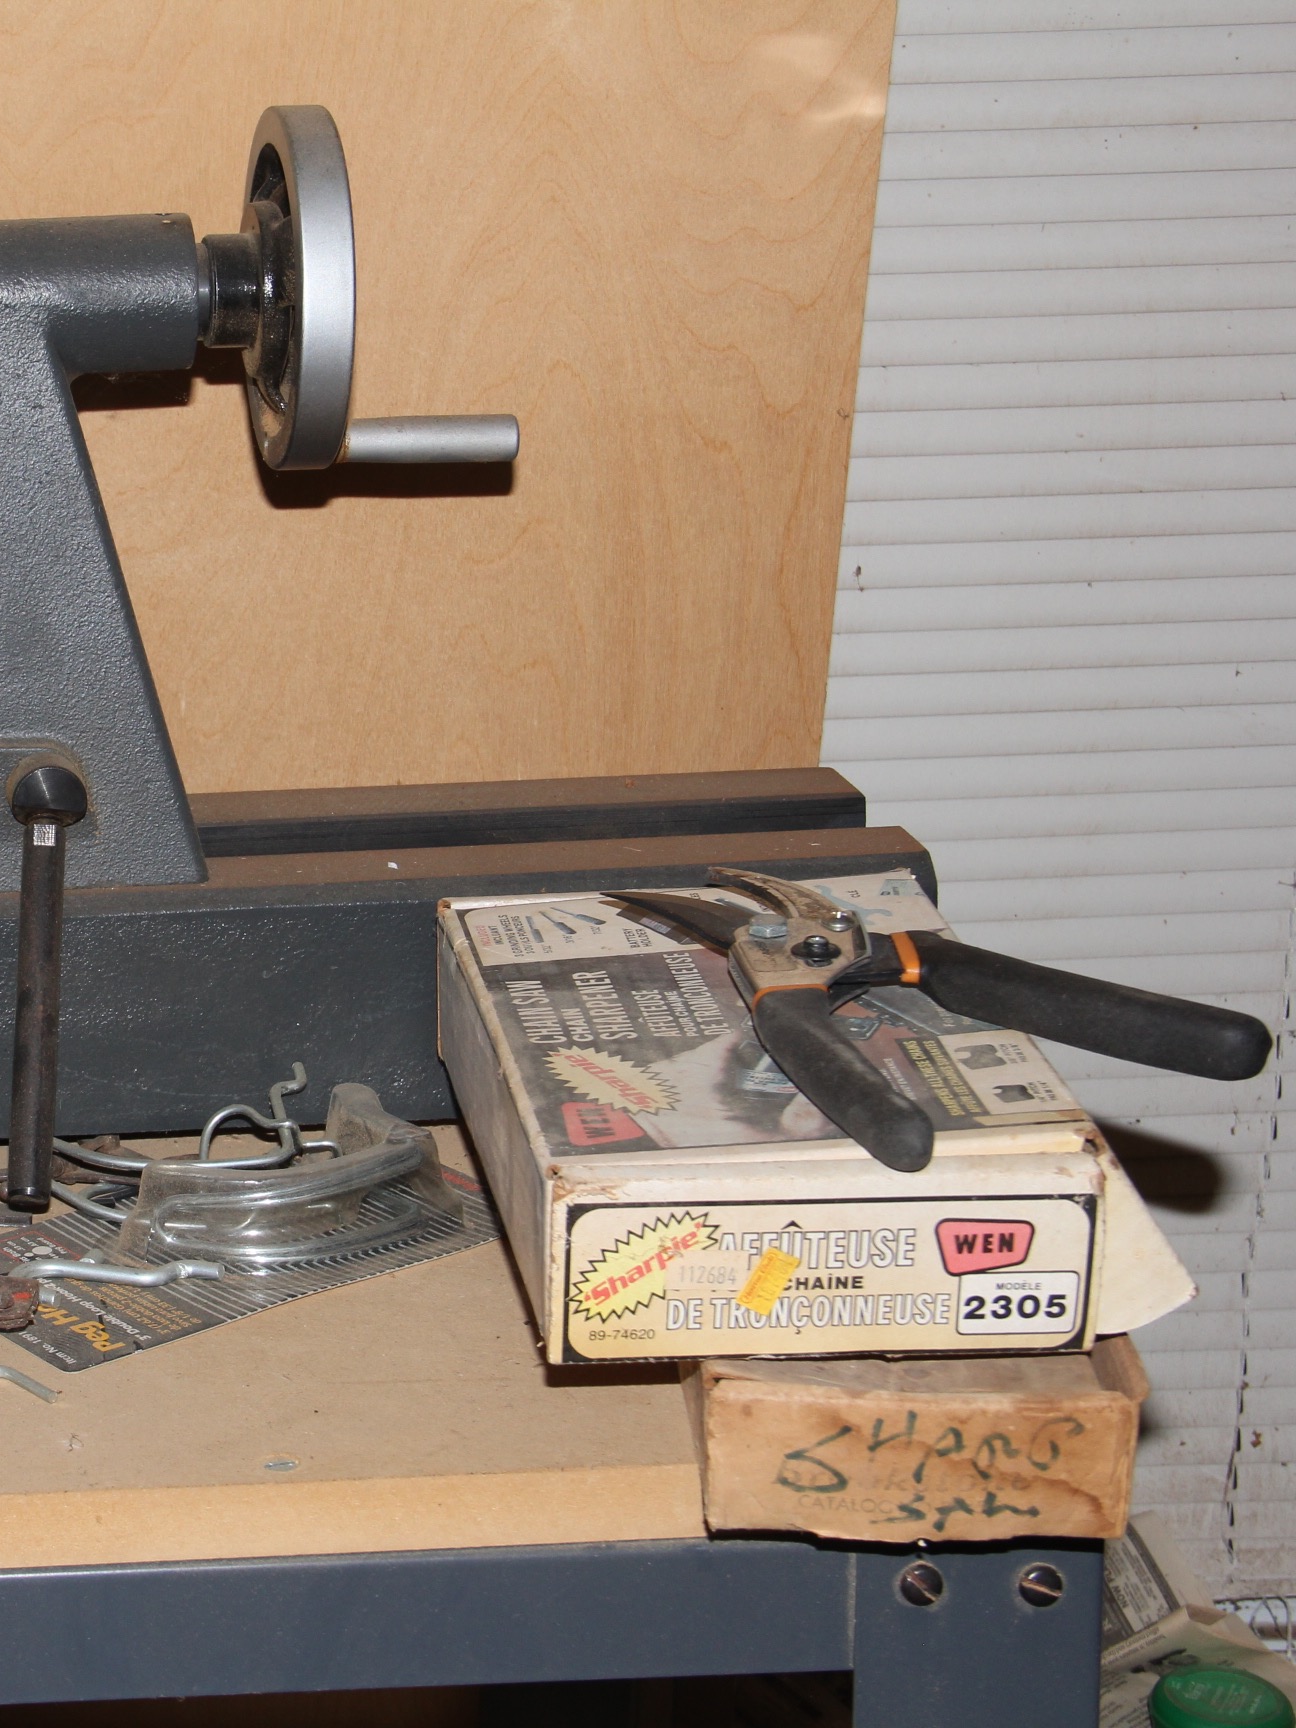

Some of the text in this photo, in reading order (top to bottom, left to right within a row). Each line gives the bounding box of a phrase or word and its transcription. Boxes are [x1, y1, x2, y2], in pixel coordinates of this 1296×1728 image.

[498, 914, 513, 934] WHEELS
[622, 928, 640, 948] BATTERY
[635, 928, 652, 948] HOLDER
[505, 981, 568, 1044] CHAIN SAW
[572, 970, 638, 1040] SHARPENER
[561, 1008, 594, 1042] CHAIN
[678, 1016, 700, 1037] POUR
[700, 1022, 732, 1036] DE
[903, 1040, 927, 1060] CHAINS
[576, 1107, 616, 1139] WEN
[953, 1231, 1016, 1255] WEN
[678, 1265, 737, 1286] 112684
[79, 1300, 105, 1317] Loop
[665, 1298, 702, 1331] DE
[963, 1294, 1067, 1320] 2305
[103, 1313, 140, 1335] Double
[588, 1328, 655, 1341] 89-74620
[69, 1321, 126, 1352] Peg
[42, 1342, 57, 1353] No.
[56, 1351, 76, 1365] Item
